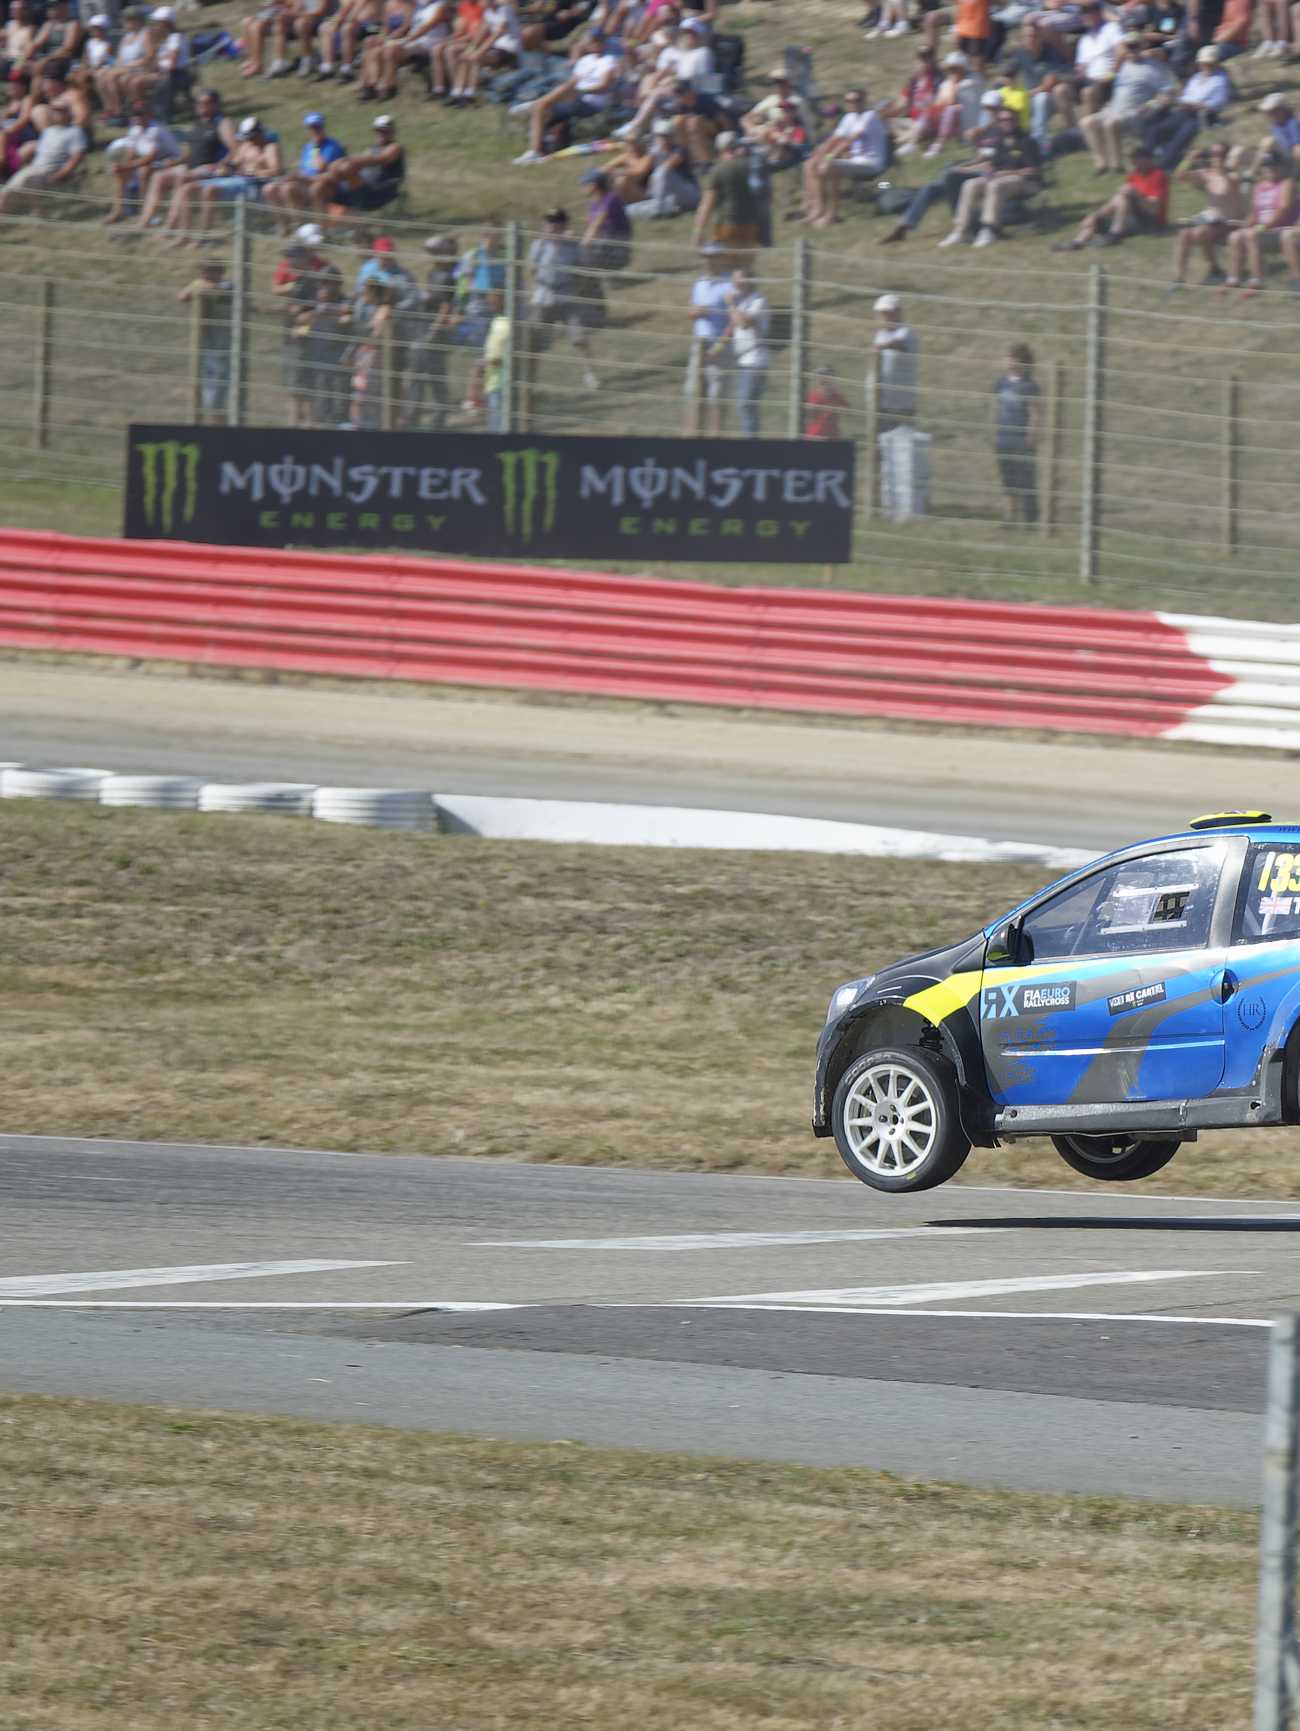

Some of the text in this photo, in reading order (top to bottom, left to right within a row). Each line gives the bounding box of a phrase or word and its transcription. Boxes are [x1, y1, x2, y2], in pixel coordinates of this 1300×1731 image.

[219, 455, 487, 505] MONSTER
[579, 457, 850, 508] MONSTER
[259, 510, 448, 531] ENERGY
[620, 516, 812, 538] ENERGY
[1135, 983, 1165, 999] CARTEL
[1023, 996, 1071, 1008] RALLYCROSS
